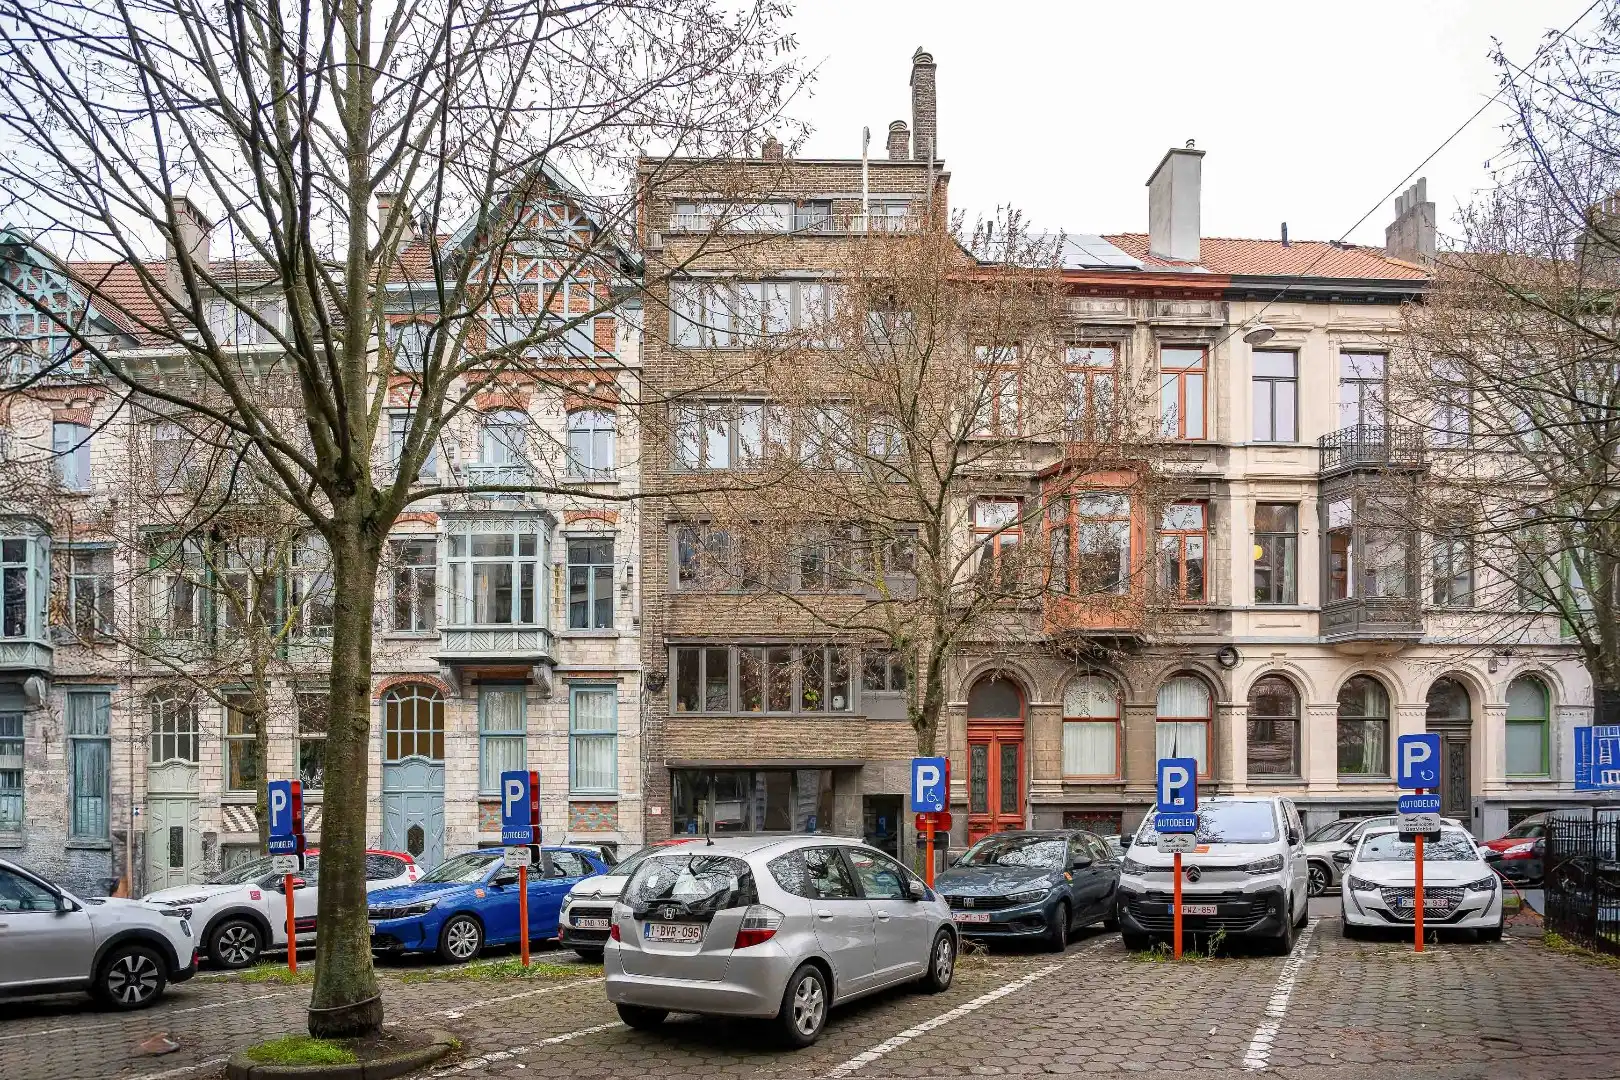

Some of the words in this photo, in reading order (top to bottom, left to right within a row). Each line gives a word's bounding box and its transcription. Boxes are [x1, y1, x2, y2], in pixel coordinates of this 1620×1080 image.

[1403, 741, 1432, 778] P
[504, 779, 525, 817] P
[916, 765, 940, 803] P
[1163, 766, 1189, 805] P
[271, 789, 287, 827] P
[1157, 818, 1195, 827] AUTODELEN
[1400, 799, 1440, 809] AUTODELEN
[502, 830, 530, 839] AUTODELEN
[651, 925, 699, 938] 1-BVR-096
